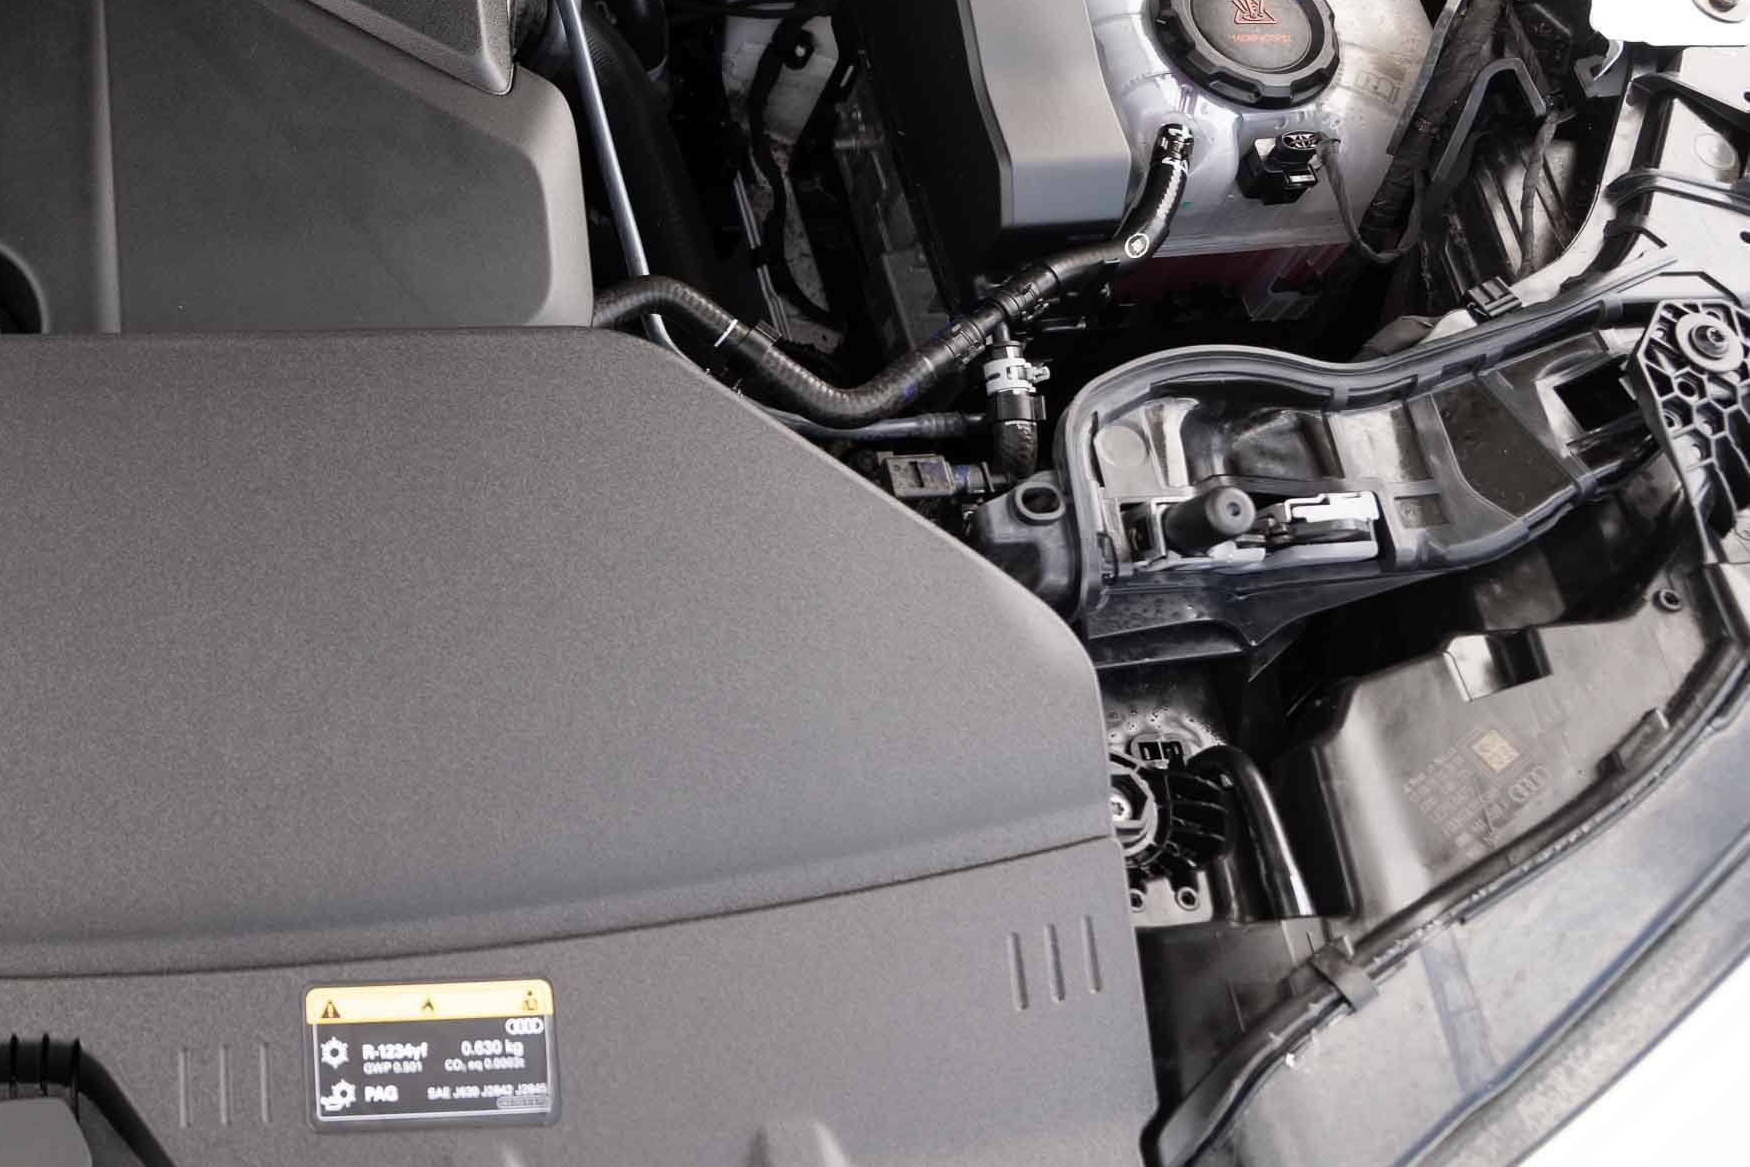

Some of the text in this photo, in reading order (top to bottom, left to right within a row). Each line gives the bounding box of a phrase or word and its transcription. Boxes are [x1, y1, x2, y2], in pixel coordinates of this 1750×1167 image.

[362, 1039, 524, 1060] R-1234yf 0.630 kg
[363, 1061, 391, 1074] GWP
[365, 1085, 398, 1102] PAG
